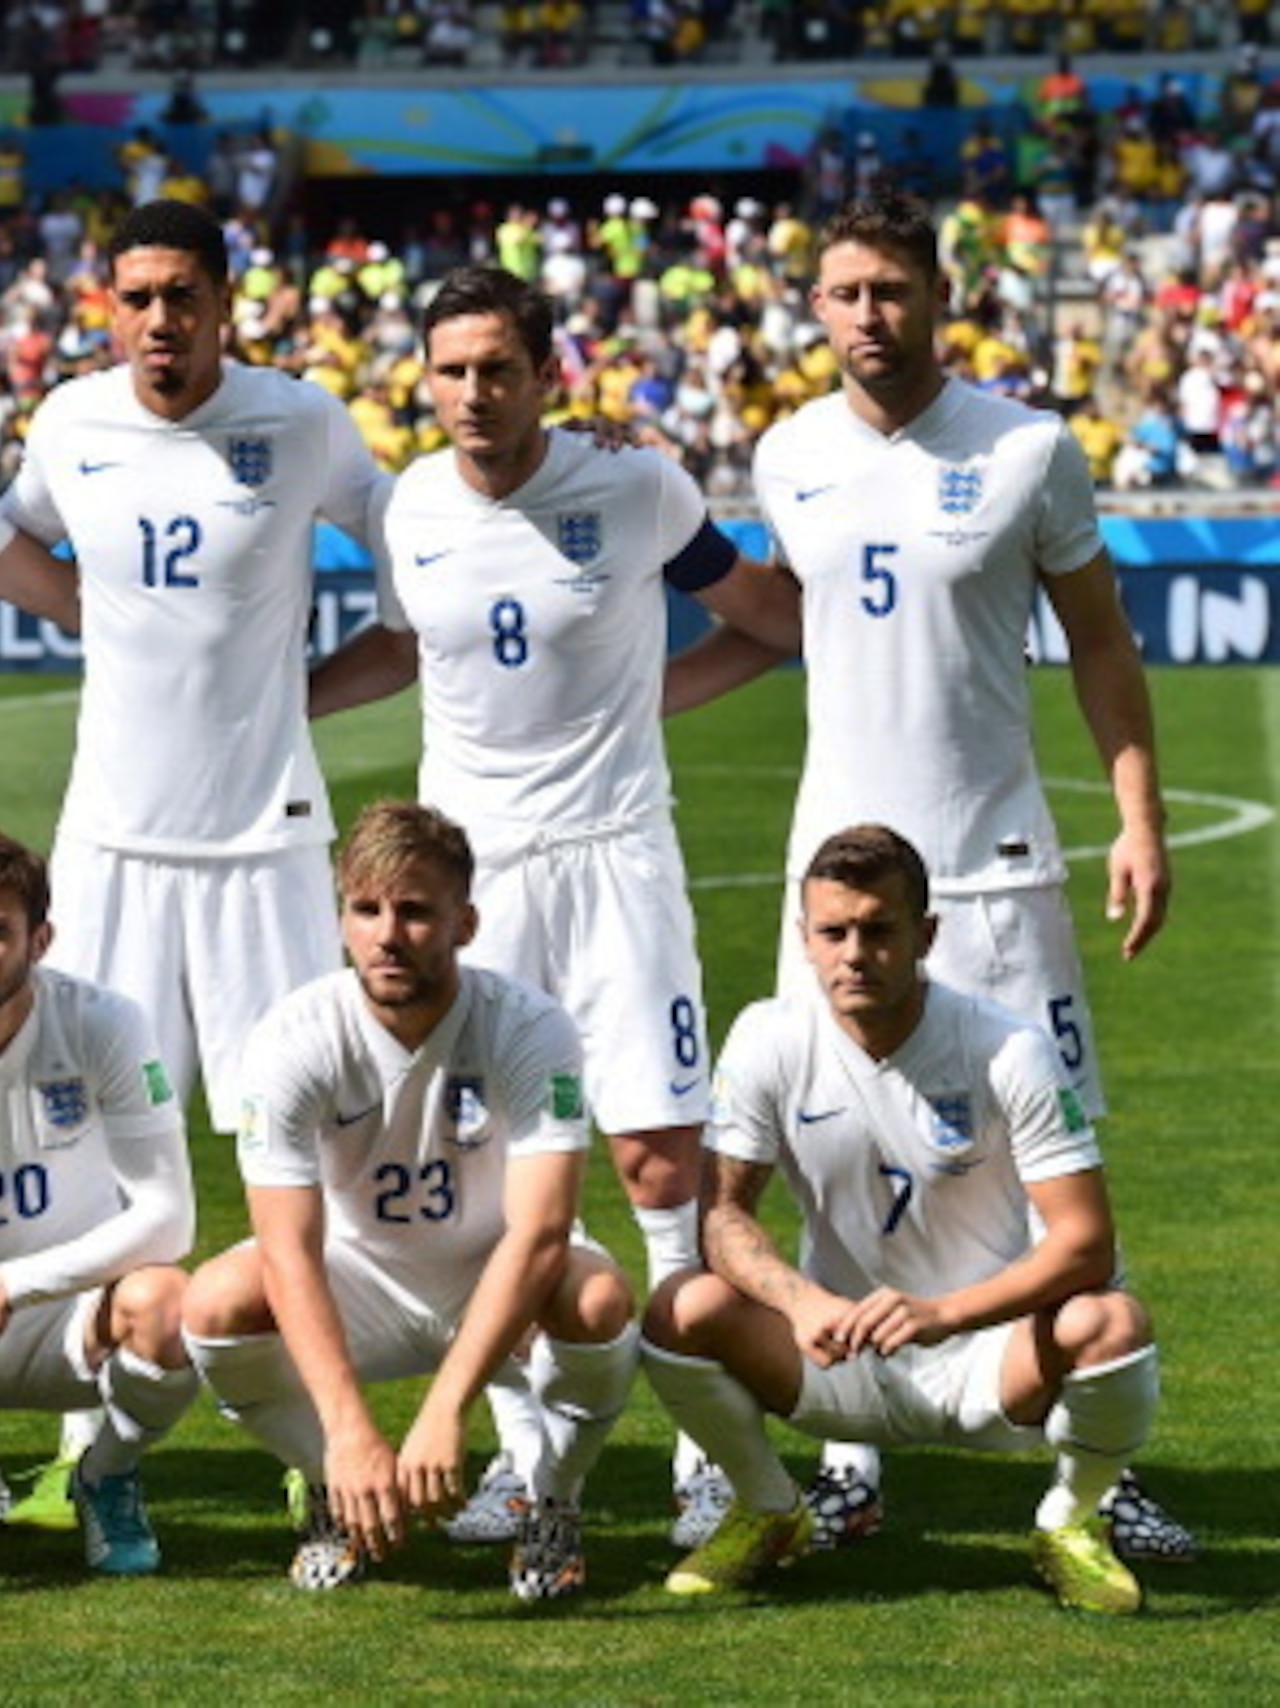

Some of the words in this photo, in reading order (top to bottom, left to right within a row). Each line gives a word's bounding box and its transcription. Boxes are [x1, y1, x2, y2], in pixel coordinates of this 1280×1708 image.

[137, 516, 203, 589] 12
[859, 543, 899, 618] 5
[489, 597, 530, 669] 8
[1167, 574, 1269, 663] IN
[668, 994, 699, 1069] 8
[1047, 994, 1086, 1070] 5
[371, 1157, 456, 1224] 23
[876, 1161, 914, 1238] 7
